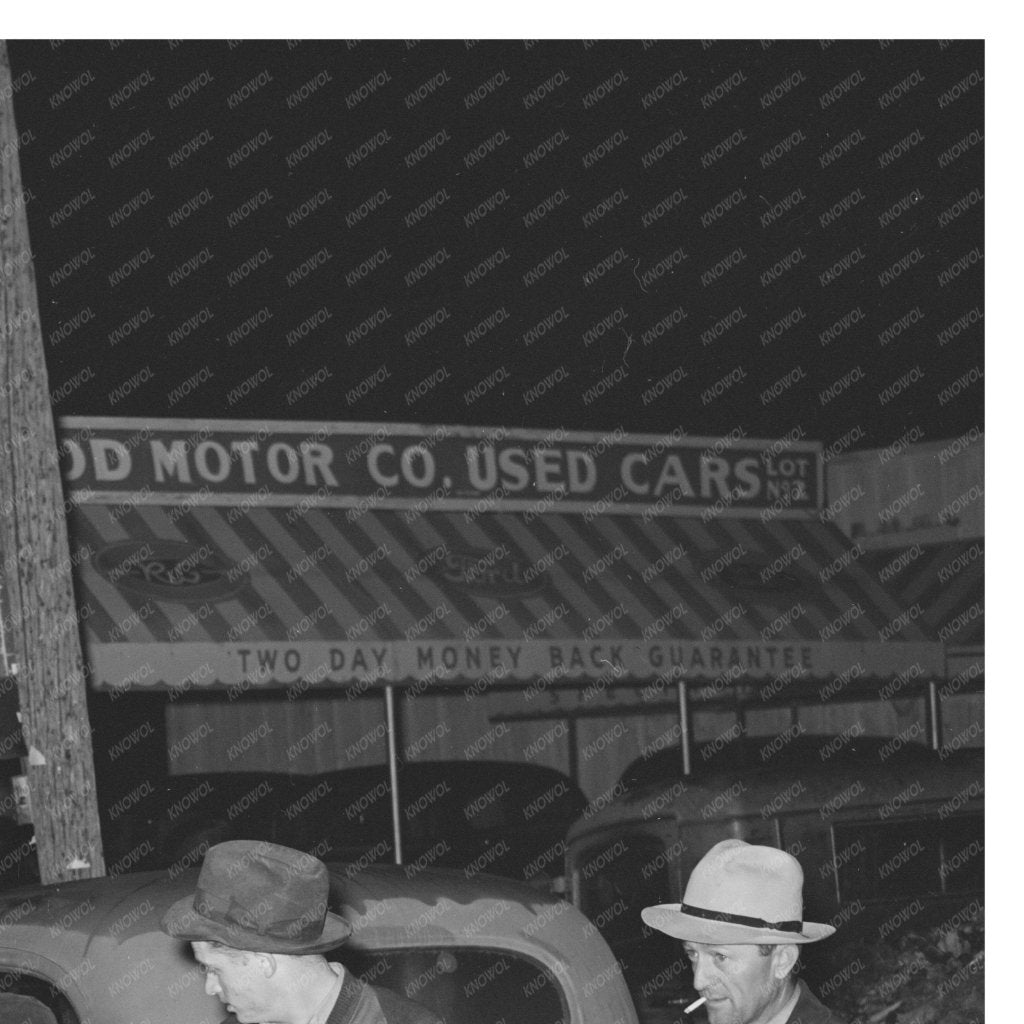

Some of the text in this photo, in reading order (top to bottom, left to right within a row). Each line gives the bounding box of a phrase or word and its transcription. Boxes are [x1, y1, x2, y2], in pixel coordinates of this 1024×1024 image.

[150, 440, 339, 487] MOTOR
[367, 444, 451, 488] CO.
[467, 443, 598, 494] USED
[620, 452, 761, 499] CARS
[766, 459, 810, 478] LOT
[238, 644, 813, 672] TWO DAY MONEY BACK GUARANTEE
